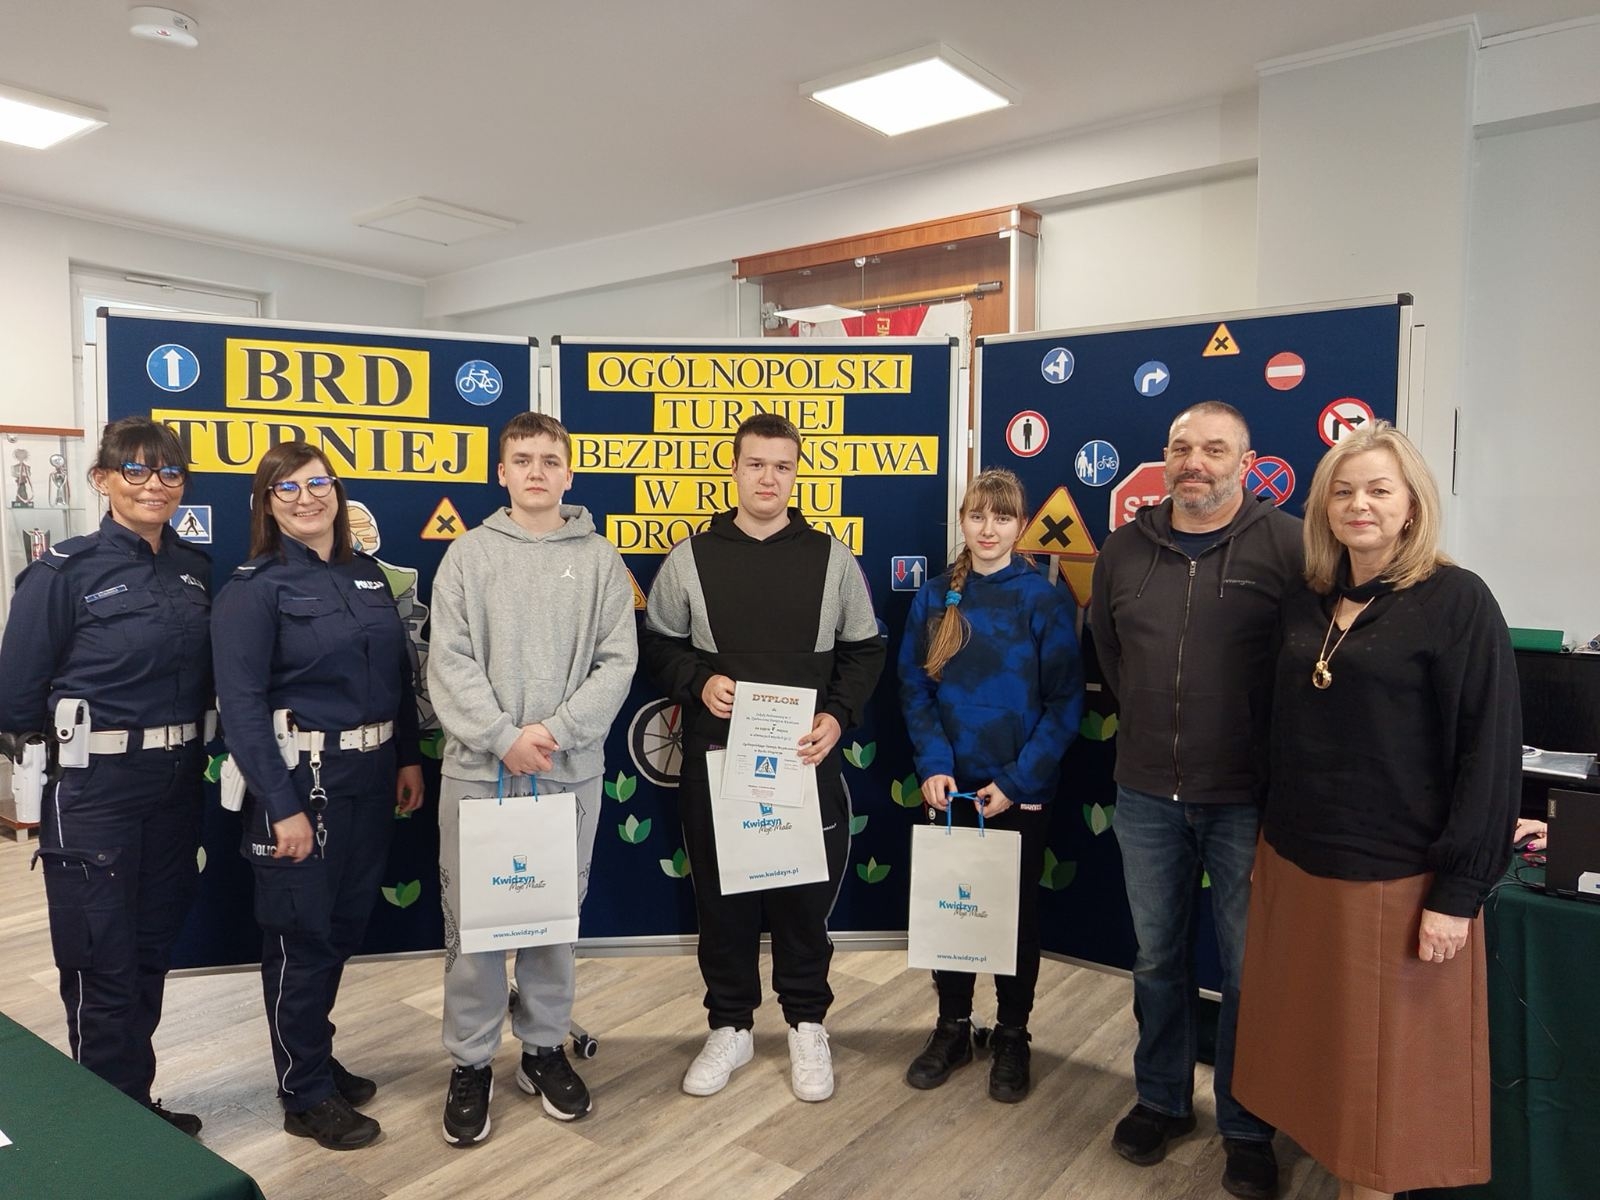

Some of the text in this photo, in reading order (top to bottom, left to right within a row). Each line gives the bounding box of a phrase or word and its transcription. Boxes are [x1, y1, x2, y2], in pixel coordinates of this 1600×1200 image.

[240, 347, 413, 407] BRD
[598, 354, 906, 390] OGÓLNOPOLSKI
[575, 437, 931, 473] BEZPIECŃSTWA
[641, 480, 836, 512] W RUHU
[752, 693, 799, 706] DYPLOM
[743, 818, 782, 830] Kwidzyn
[748, 867, 799, 880] www.kwidzyn.pl
[492, 875, 535, 886] Kwidzyn
[939, 900, 978, 912] Kwidzyn
[493, 927, 547, 939] www.kwidzyn.pl
[937, 954, 987, 963] www.kwidzyn.pl
